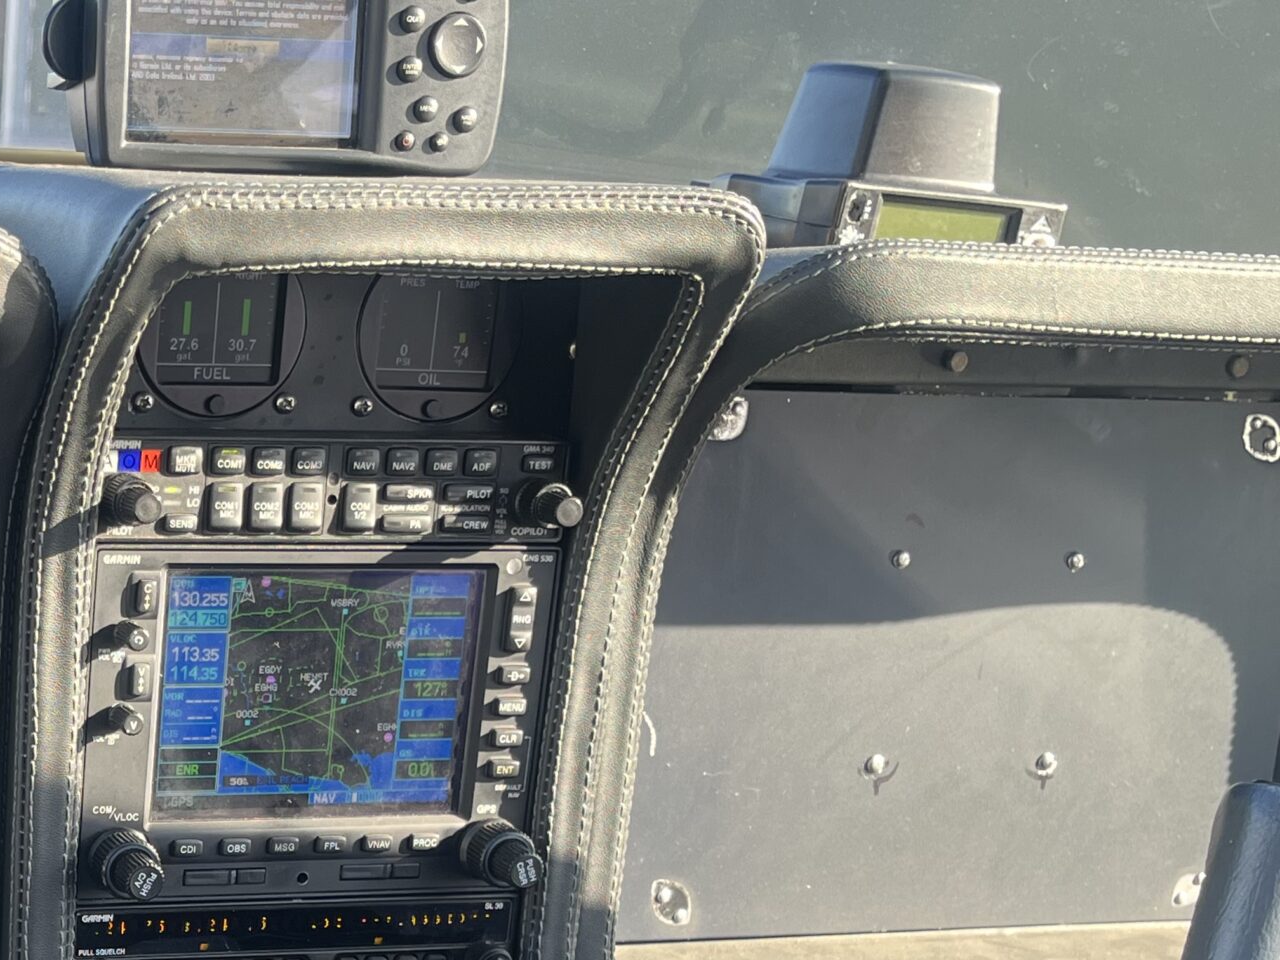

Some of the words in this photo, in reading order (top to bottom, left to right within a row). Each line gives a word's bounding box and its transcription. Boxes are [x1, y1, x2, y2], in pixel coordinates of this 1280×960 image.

[170, 338, 198, 350] 27.6
[228, 339, 256, 351] 30.7
[194, 367, 230, 380] FUEL
[418, 373, 440, 386] OIL
[217, 459, 242, 469] COM1
[257, 461, 283, 470] COM2
[297, 461, 322, 469] COM3
[353, 462, 375, 470] NAV1
[392, 462, 415, 471] NAV2
[433, 462, 453, 471] DME
[472, 463, 491, 471] ADF
[529, 461, 552, 470] TEST
[466, 490, 492, 498] PILOT
[169, 519, 193, 528] SENS
[463, 521, 488, 529] CREW
[103, 555, 141, 564] GARMIN
[173, 592, 228, 607] 130.255
[171, 612, 227, 626] 124.750
[512, 615, 531, 624] RNG
[170, 667, 218, 681] 114.35
[499, 703, 524, 712] MENU
[500, 734, 517, 743] CLR
[176, 765, 199, 775] ENR
[496, 766, 514, 775] ENT
[314, 793, 335, 803] NAV
[476, 804, 497, 814] GPS
[274, 843, 295, 851] MSG
[324, 841, 340, 850] FPL
[368, 840, 391, 849] VNAV
[413, 838, 437, 848] PROC
[180, 846, 196, 854] CDI
[227, 844, 246, 853] OBS
[82, 914, 114, 923] GARMIN
